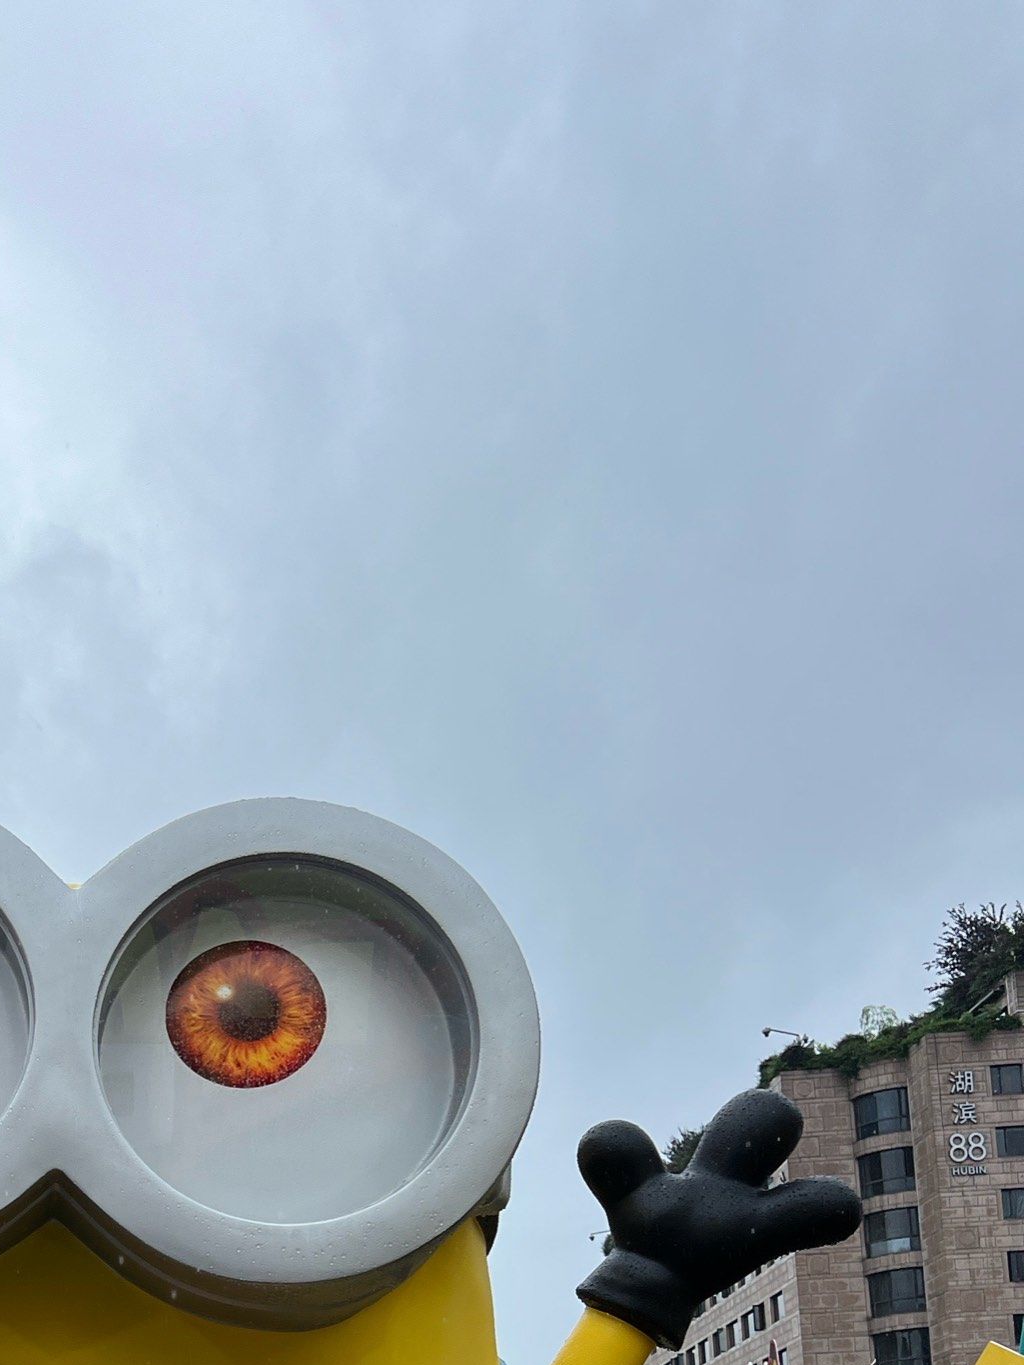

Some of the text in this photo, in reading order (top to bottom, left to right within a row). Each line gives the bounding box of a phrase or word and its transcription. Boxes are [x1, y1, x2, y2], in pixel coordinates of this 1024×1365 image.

[950, 1070, 977, 1125] 湖滨
[949, 1132, 987, 1162] 88
[952, 1166, 986, 1177] HUBIN
